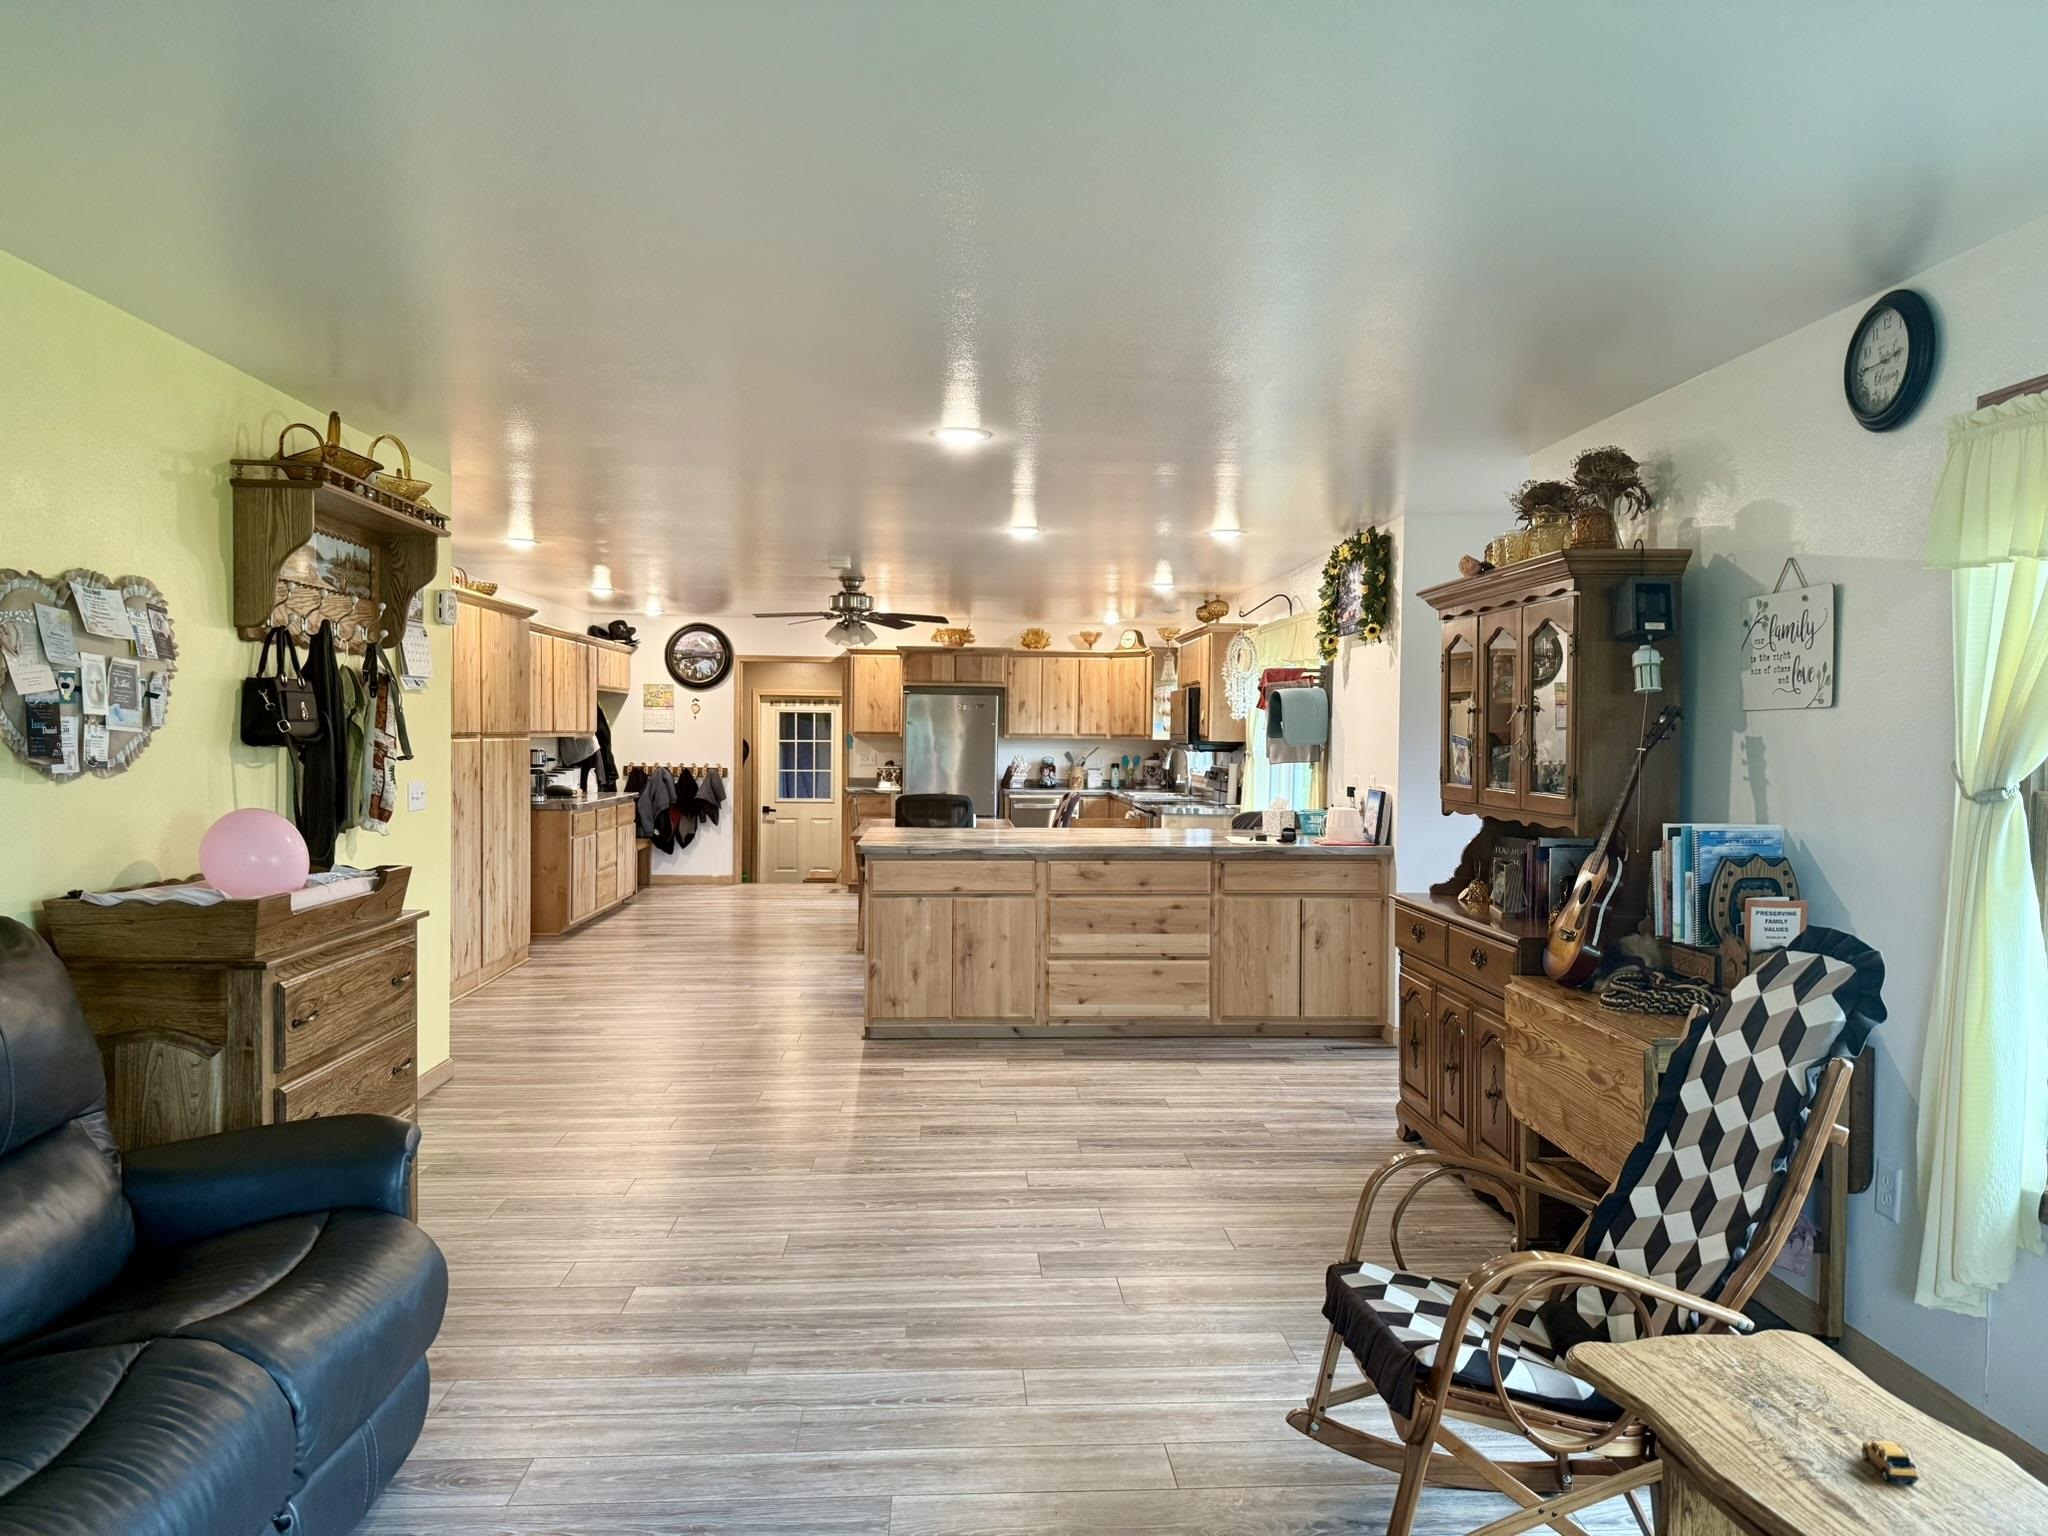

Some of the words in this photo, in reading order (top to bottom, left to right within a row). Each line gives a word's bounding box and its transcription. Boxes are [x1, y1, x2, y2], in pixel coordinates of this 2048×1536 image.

[1884, 315, 1892, 331] 12
[1872, 327, 1879, 342] 11
[1769, 608, 1828, 652] family
[1759, 654, 1770, 662] the
[1773, 651, 1791, 663] right
[1763, 664, 1771, 674] of
[1778, 674, 1789, 684] and
[1792, 654, 1815, 694] love
[1494, 845, 1510, 854] YOU
